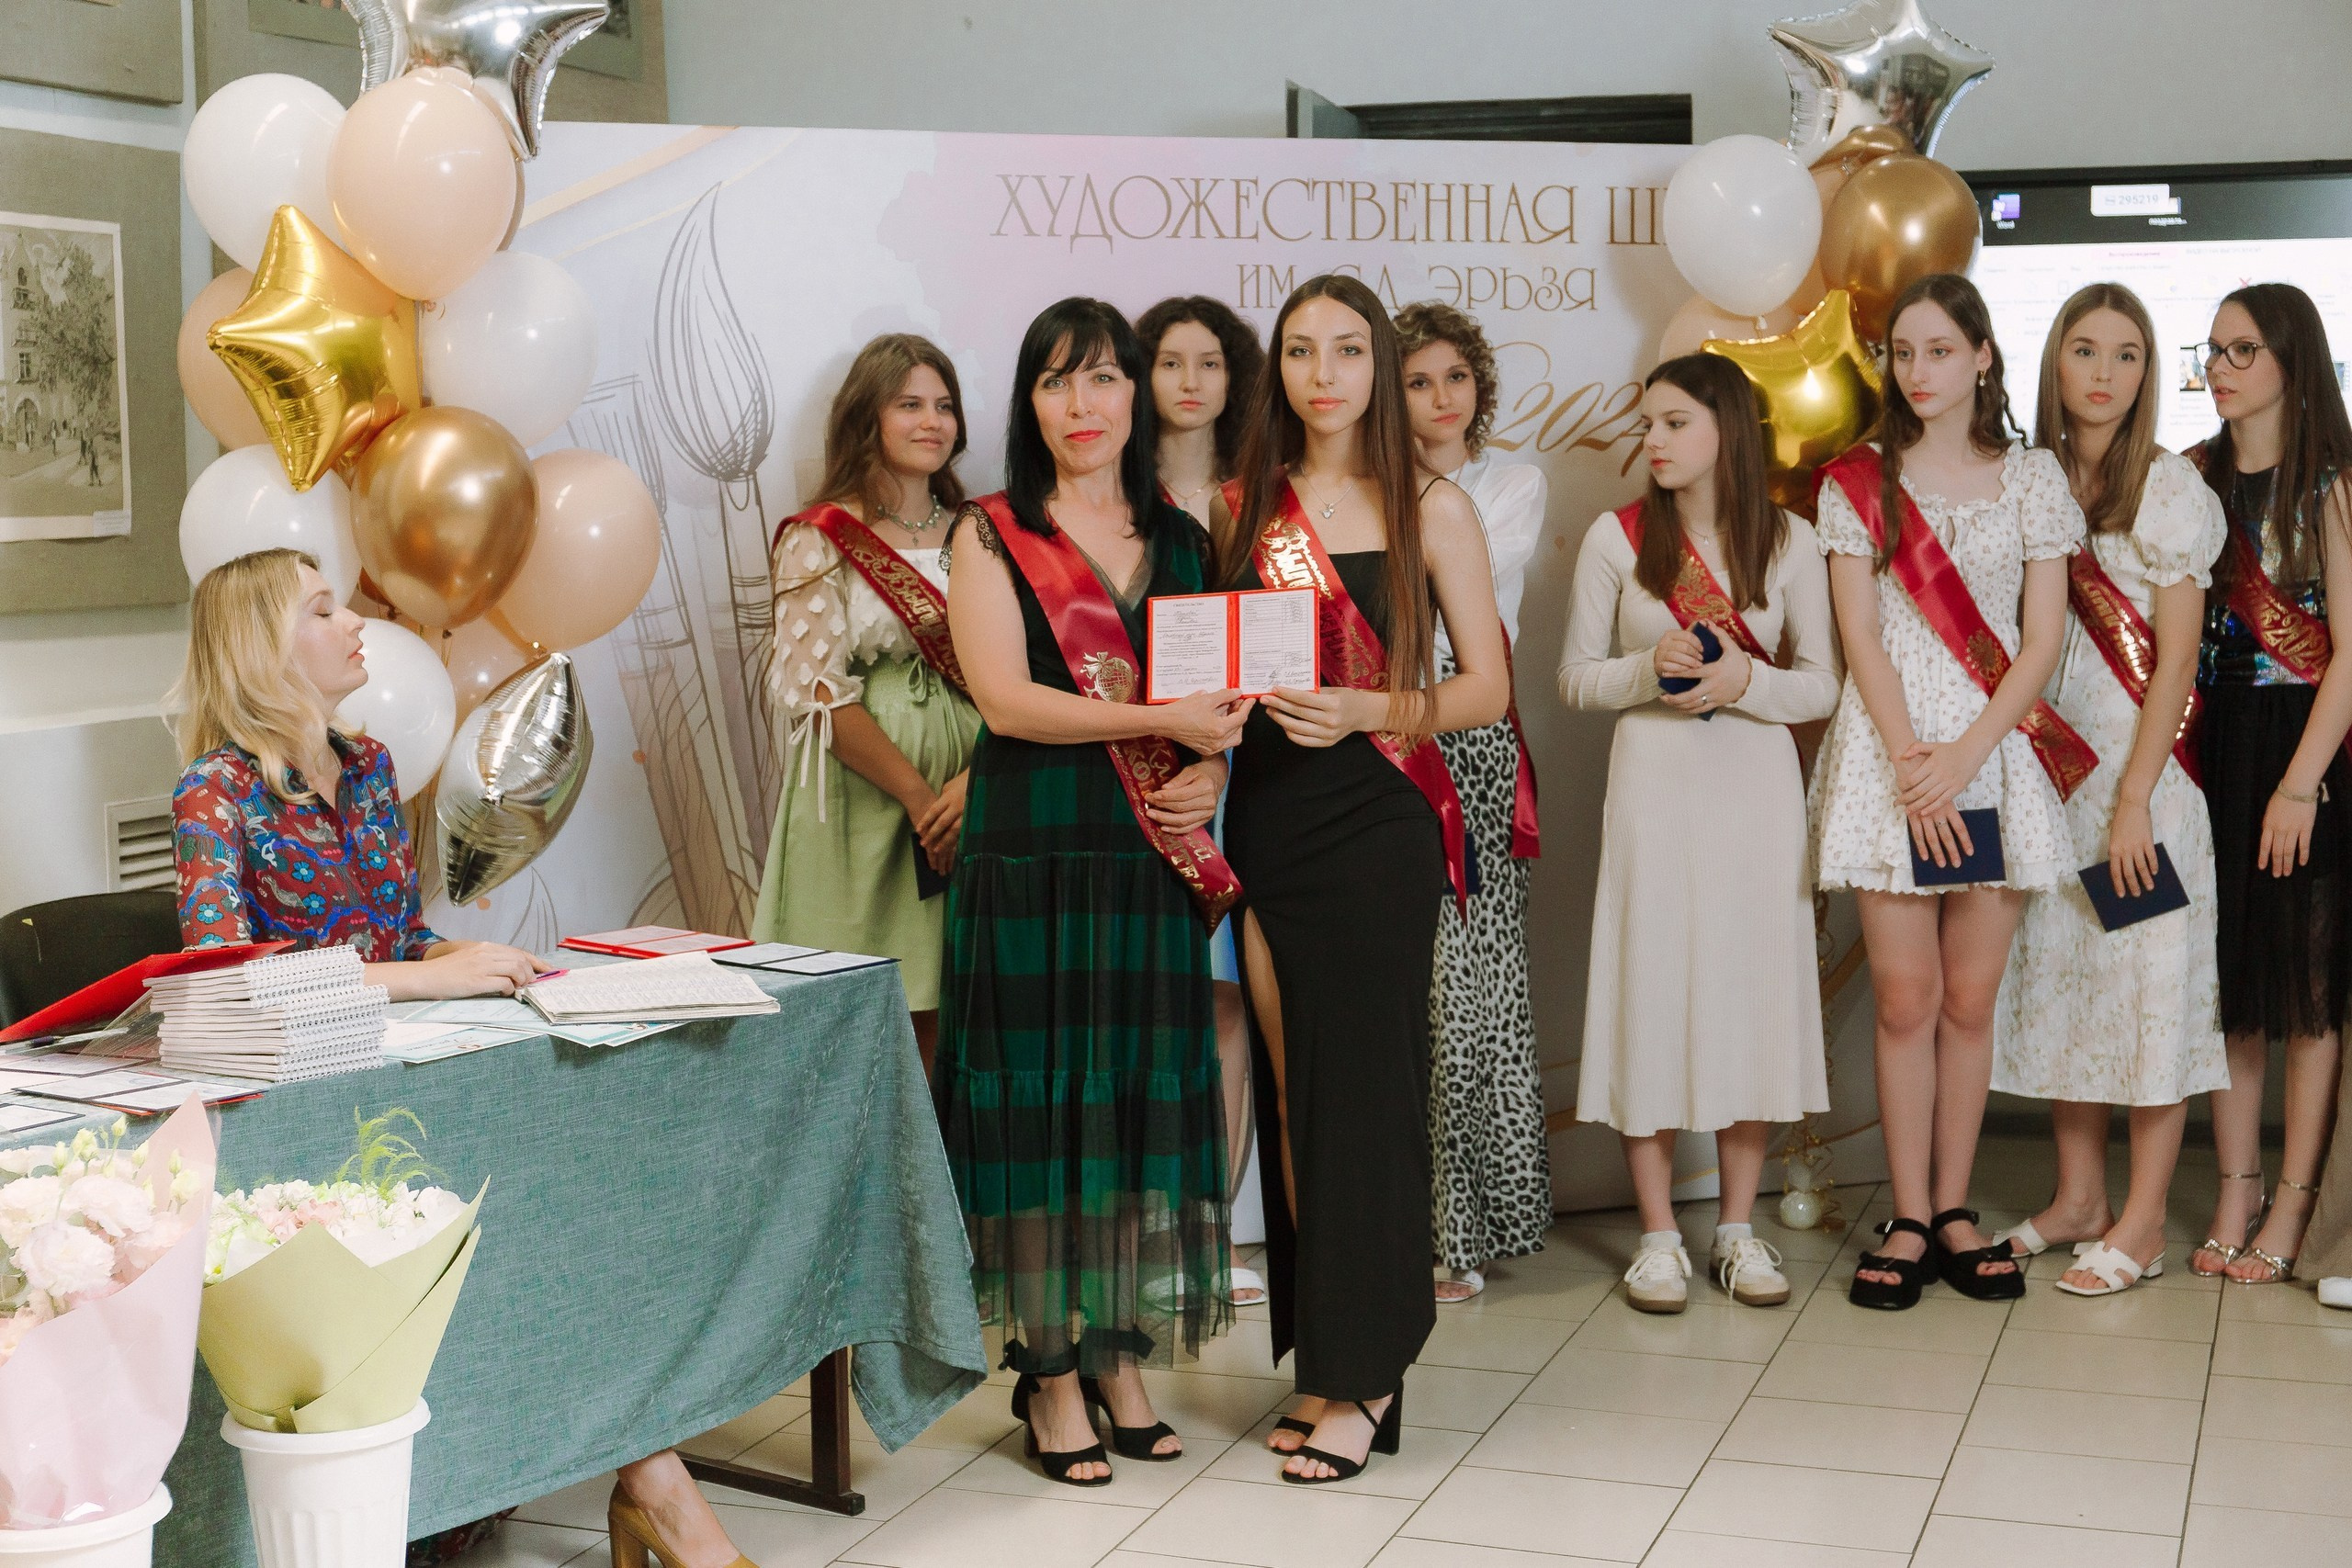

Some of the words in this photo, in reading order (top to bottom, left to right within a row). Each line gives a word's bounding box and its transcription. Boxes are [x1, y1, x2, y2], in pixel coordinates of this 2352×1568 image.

[990, 172, 1578, 254] ХУДОЖЕСТВЕННАЯ
[1605, 186, 1668, 246] Ш
[2118, 194, 2159, 206] 295219
[1428, 264, 1599, 312] ЭРЬЗЯ
[1483, 380, 1647, 478] 2024
